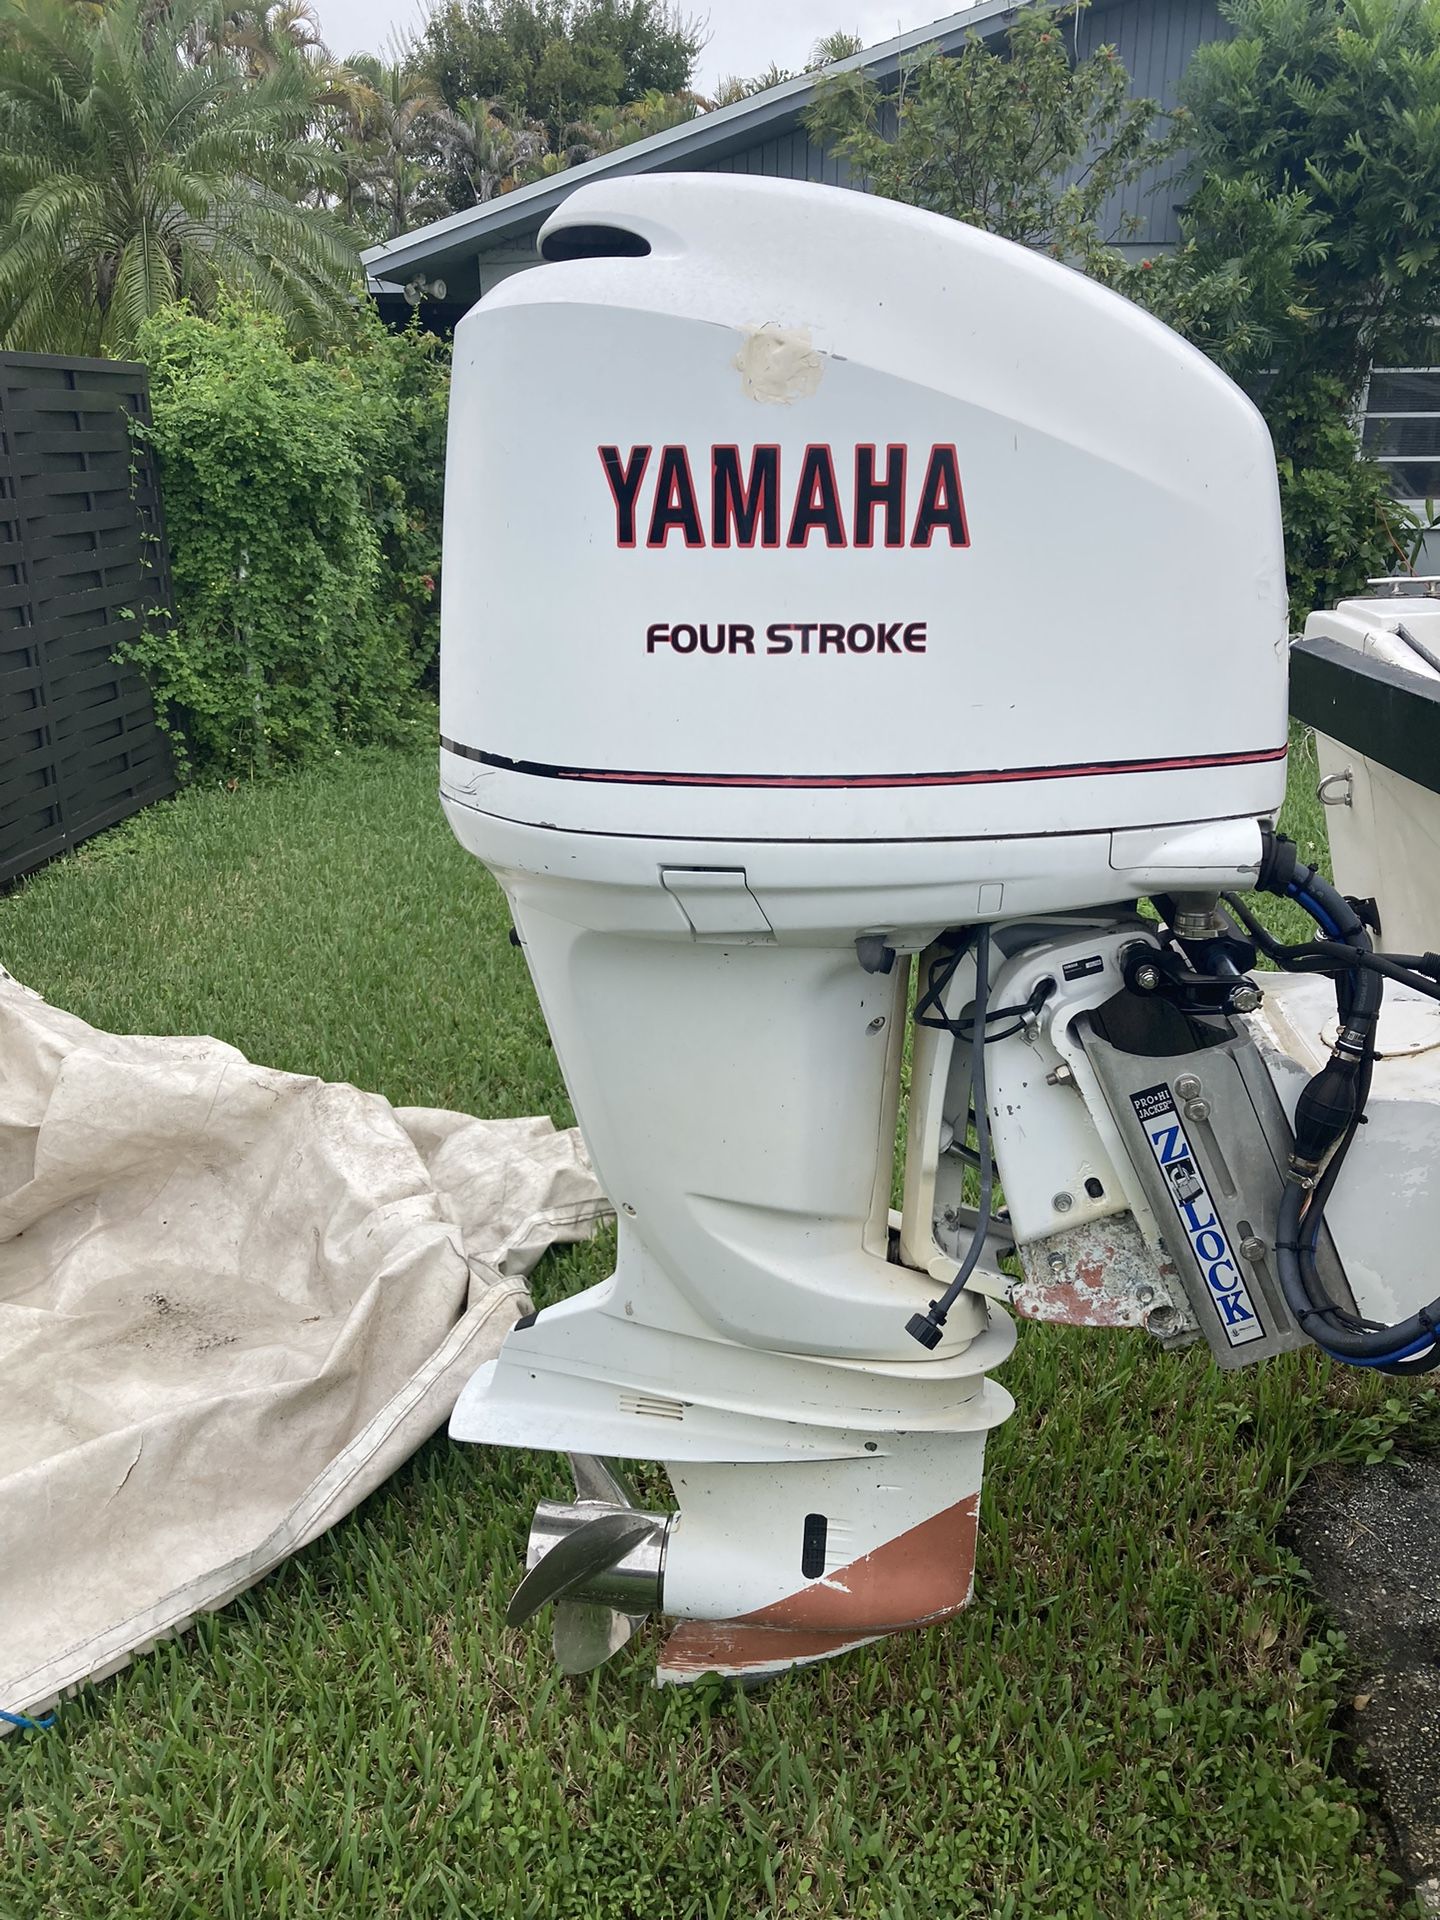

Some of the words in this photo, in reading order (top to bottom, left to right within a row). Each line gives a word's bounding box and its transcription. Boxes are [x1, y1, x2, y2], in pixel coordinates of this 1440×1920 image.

[597, 443, 971, 548] YAMAHA
[646, 622, 756, 655] FOUR
[766, 621, 927, 655] STROKE
[1179, 1199, 1254, 1326] LOCK
